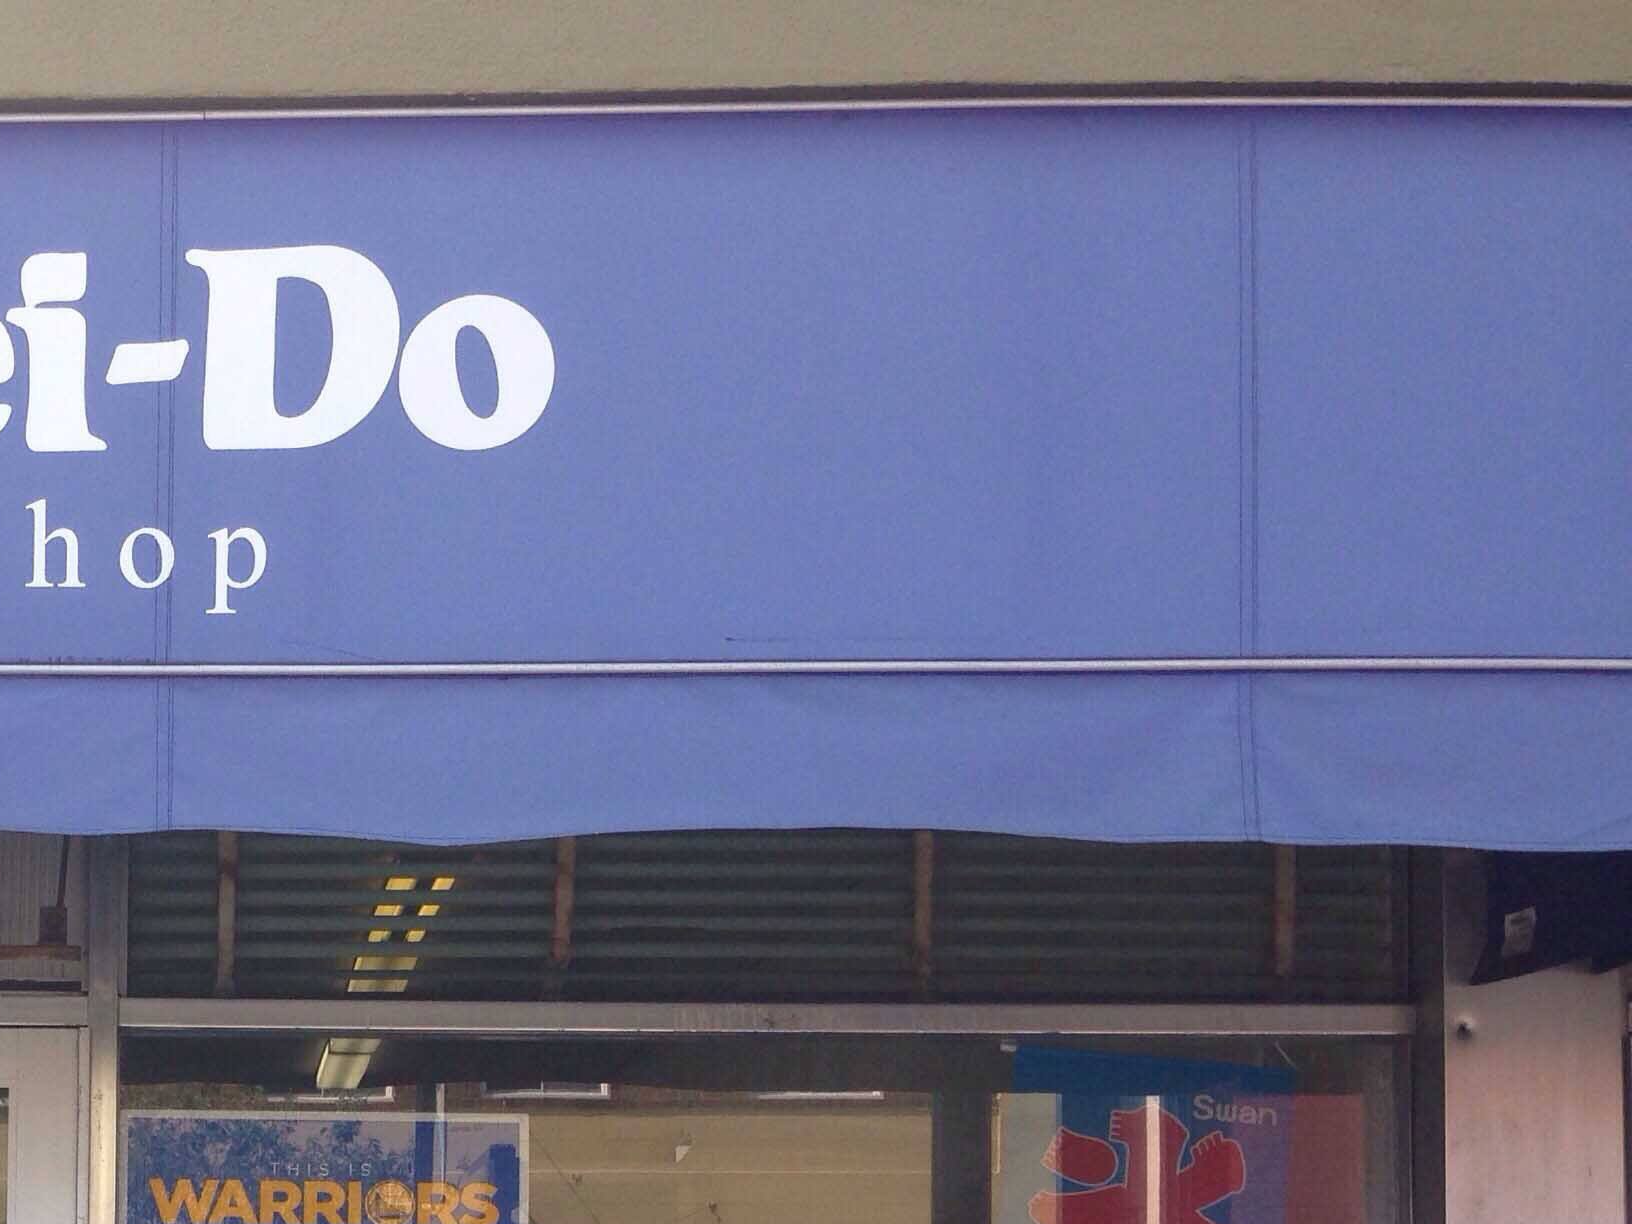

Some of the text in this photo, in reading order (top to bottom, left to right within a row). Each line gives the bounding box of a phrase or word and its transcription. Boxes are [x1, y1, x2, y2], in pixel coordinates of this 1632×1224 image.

[1192, 1094, 1278, 1126] Swan
[271, 1162, 372, 1177] THIS IS
